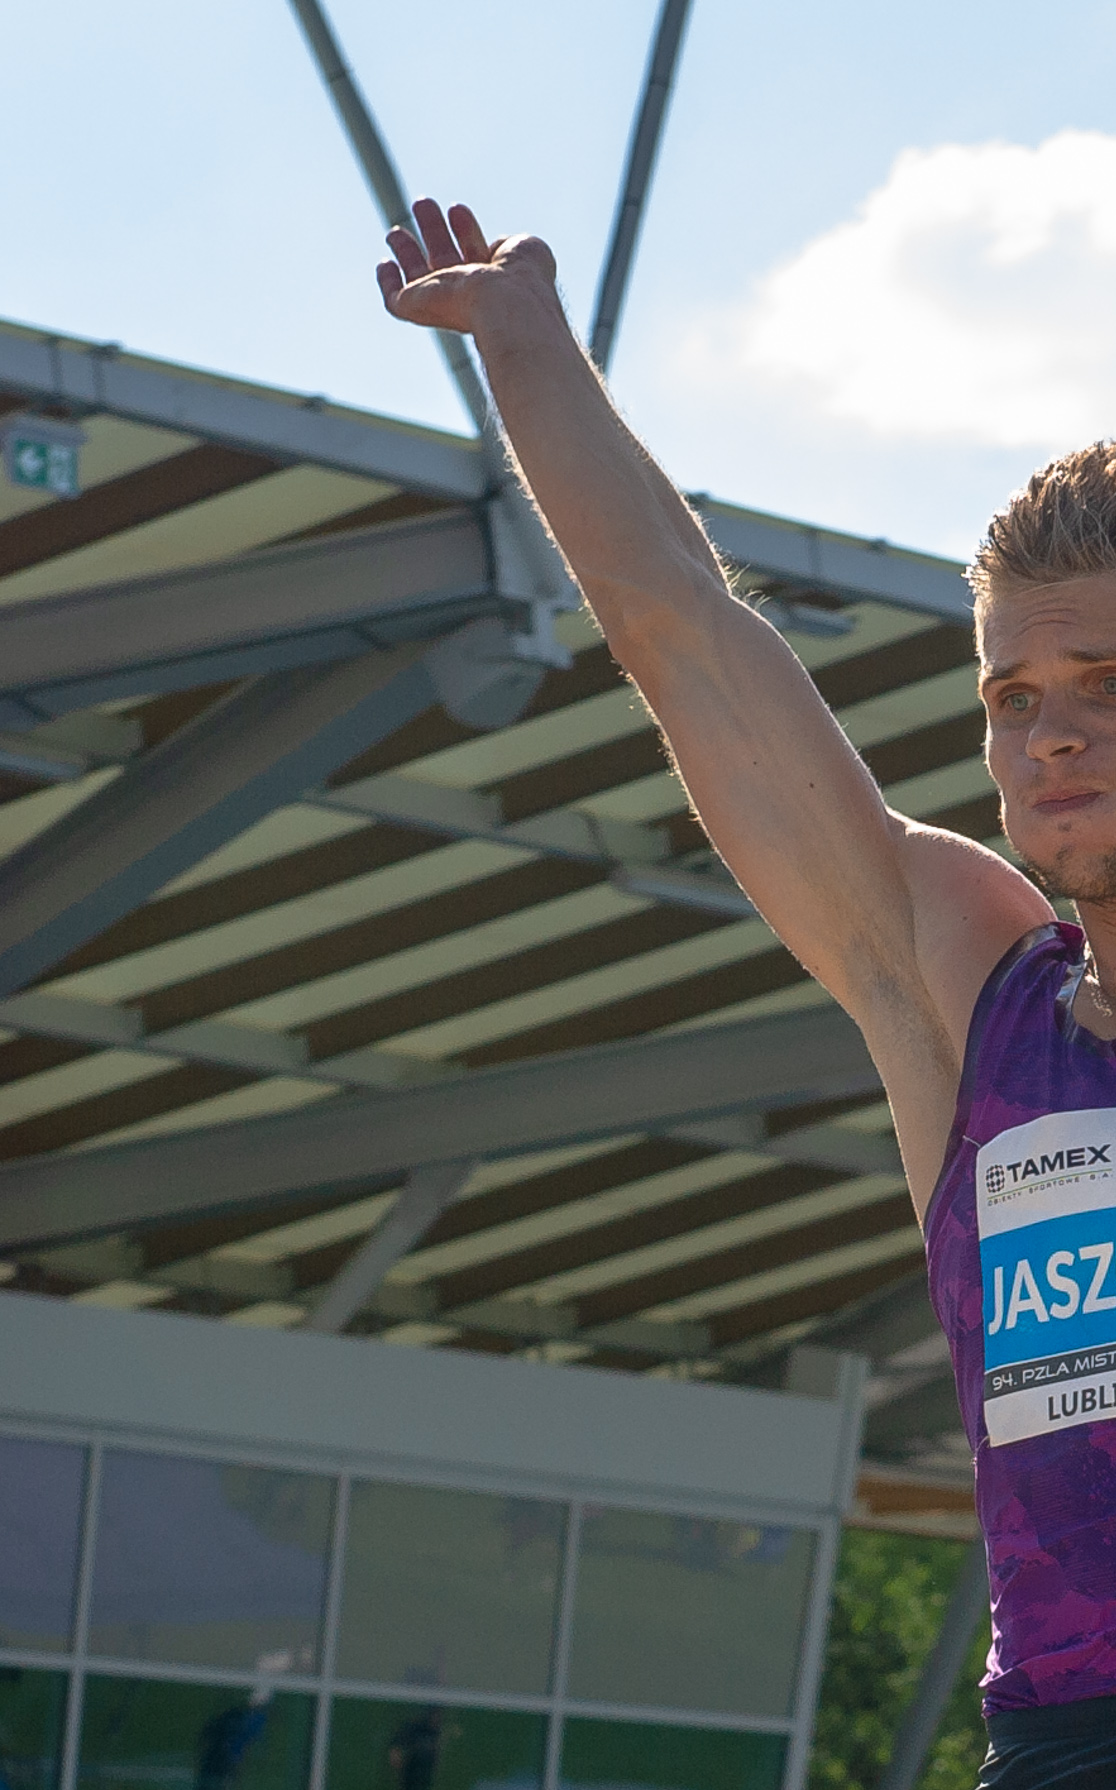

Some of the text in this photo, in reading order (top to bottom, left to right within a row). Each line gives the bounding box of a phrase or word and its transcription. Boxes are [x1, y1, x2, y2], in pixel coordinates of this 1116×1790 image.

[1006, 1143, 1112, 1184] TAMEX
[992, 1372, 1018, 1391] 94.
[1022, 1361, 1070, 1384] PZLA
